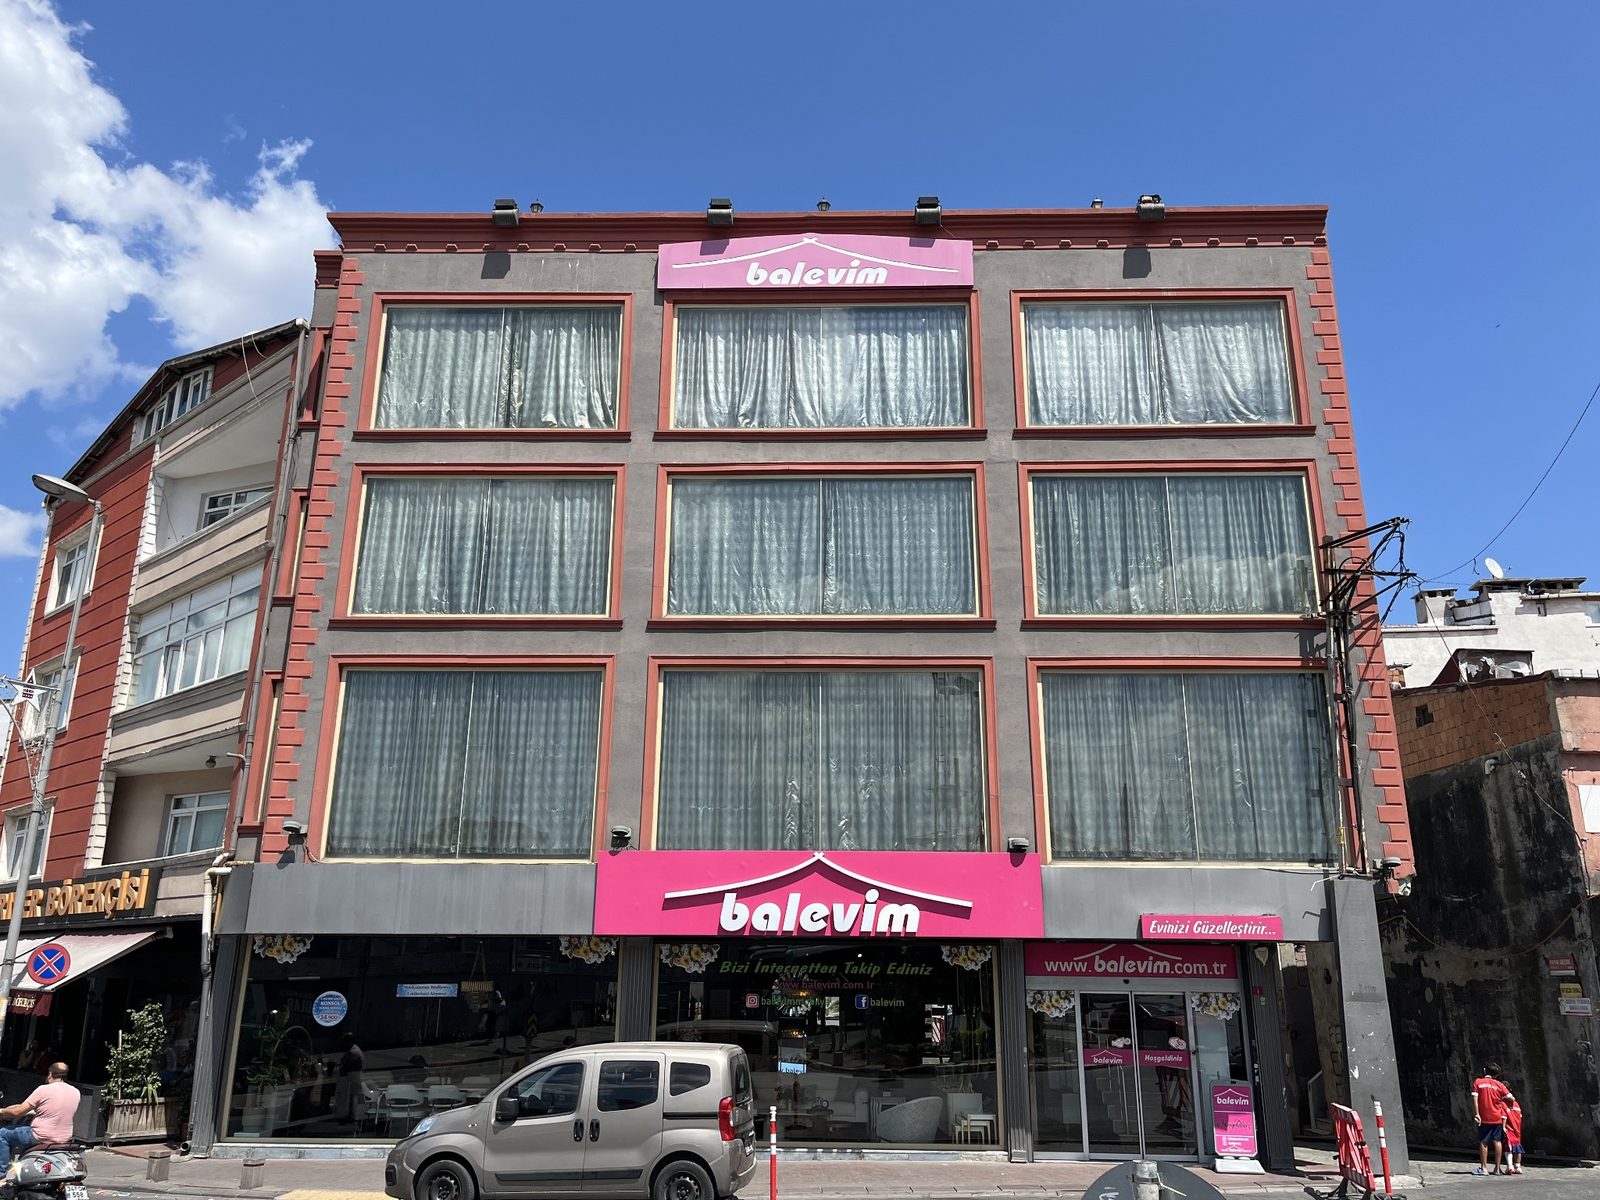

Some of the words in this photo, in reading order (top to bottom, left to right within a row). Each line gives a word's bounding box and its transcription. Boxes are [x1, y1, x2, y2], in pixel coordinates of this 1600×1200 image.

[746, 259, 888, 285] balevim
[45, 868, 150, 919] BÖREKÇİSİ
[719, 888, 921, 933] balevim
[1149, 920, 1190, 934] Evinizi
[1193, 920, 1276, 937] Güzelleştirir...
[719, 961, 750, 974] Bizi
[844, 962, 881, 977] Takip
[886, 963, 934, 975] Ediniz
[1045, 955, 1227, 975] www.balevim.com.tr
[870, 997, 905, 1007] balevim
[1093, 1056, 1123, 1064] balevim
[1216, 1096, 1249, 1105] balevim
